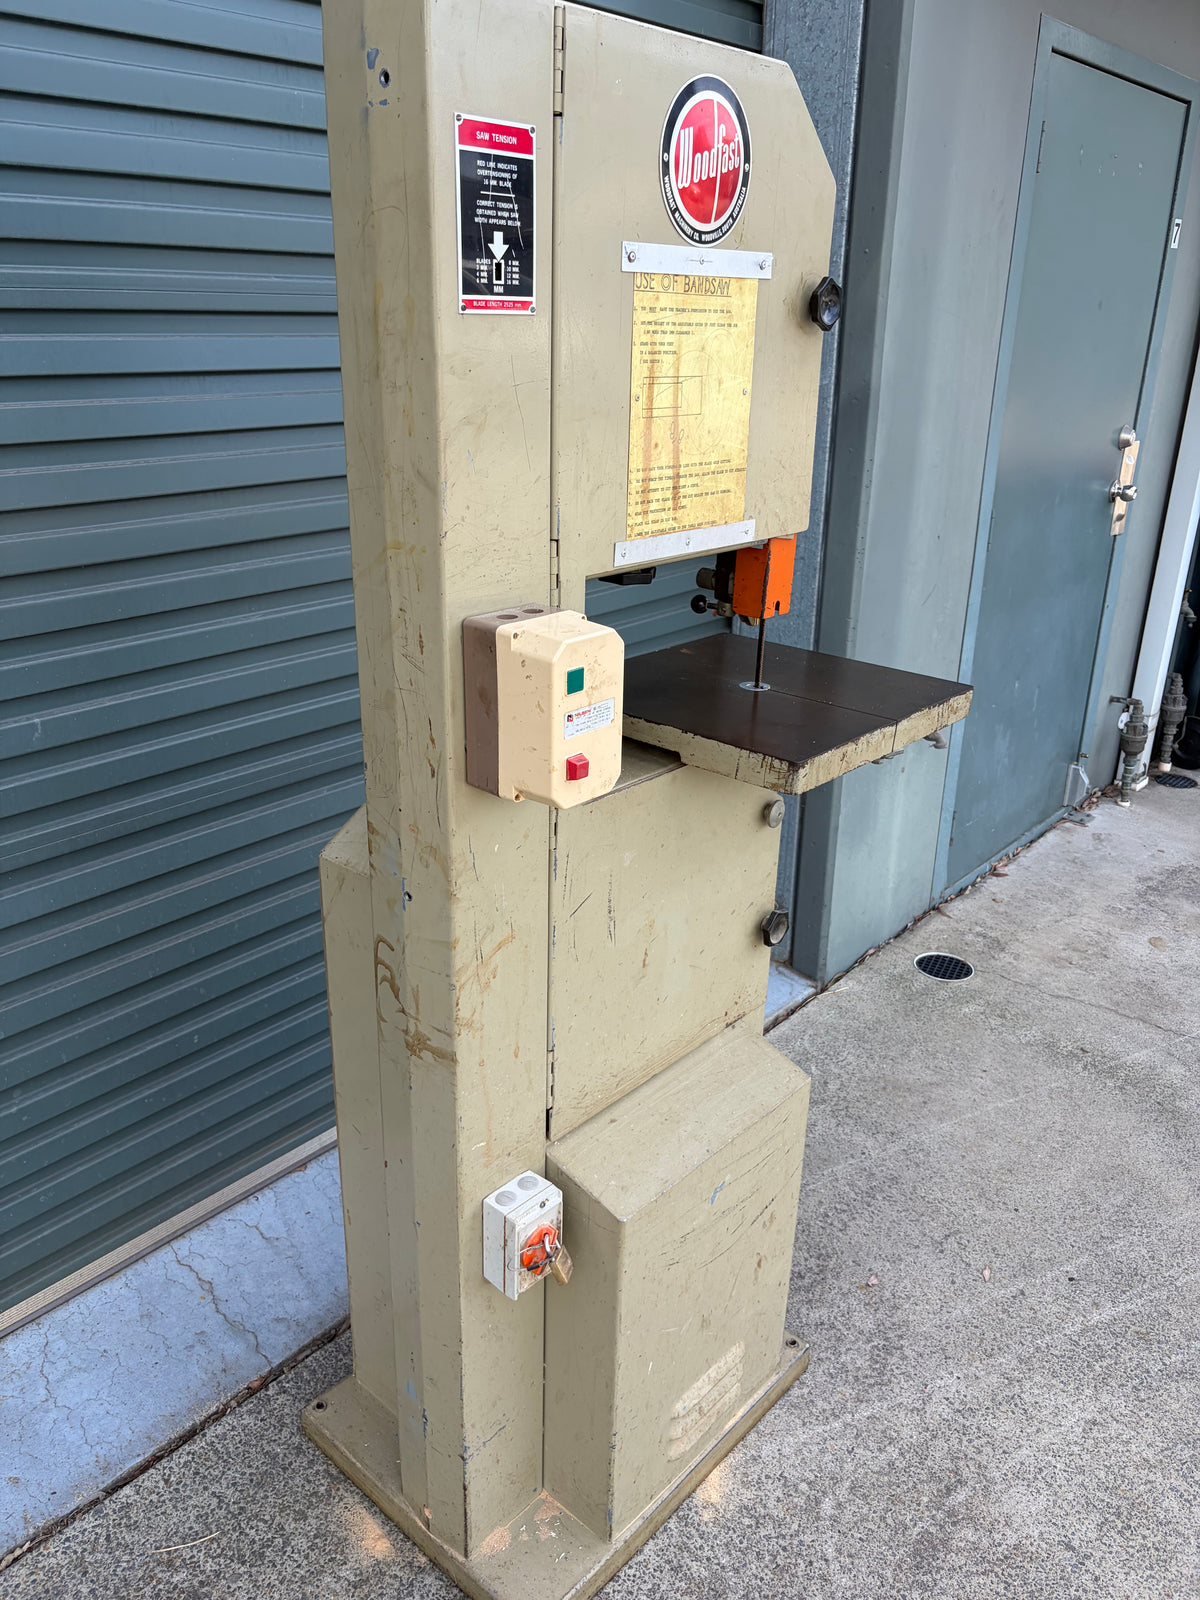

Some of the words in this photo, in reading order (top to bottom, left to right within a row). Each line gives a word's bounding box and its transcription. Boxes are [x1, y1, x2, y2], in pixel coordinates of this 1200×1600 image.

[476, 131, 489, 140] SAW
[492, 133, 517, 144] TENSION
[497, 163, 517, 171] INDICATES
[664, 175, 676, 210] WOODFAST
[674, 211, 693, 237] MACHINERY
[722, 217, 733, 234] SOUTH
[732, 187, 746, 218] AUSTRALIA
[1175, 222, 1180, 243] 7
[635, 273, 654, 289] USE
[661, 274, 678, 291] OF
[684, 275, 730, 295] BANDSAW
